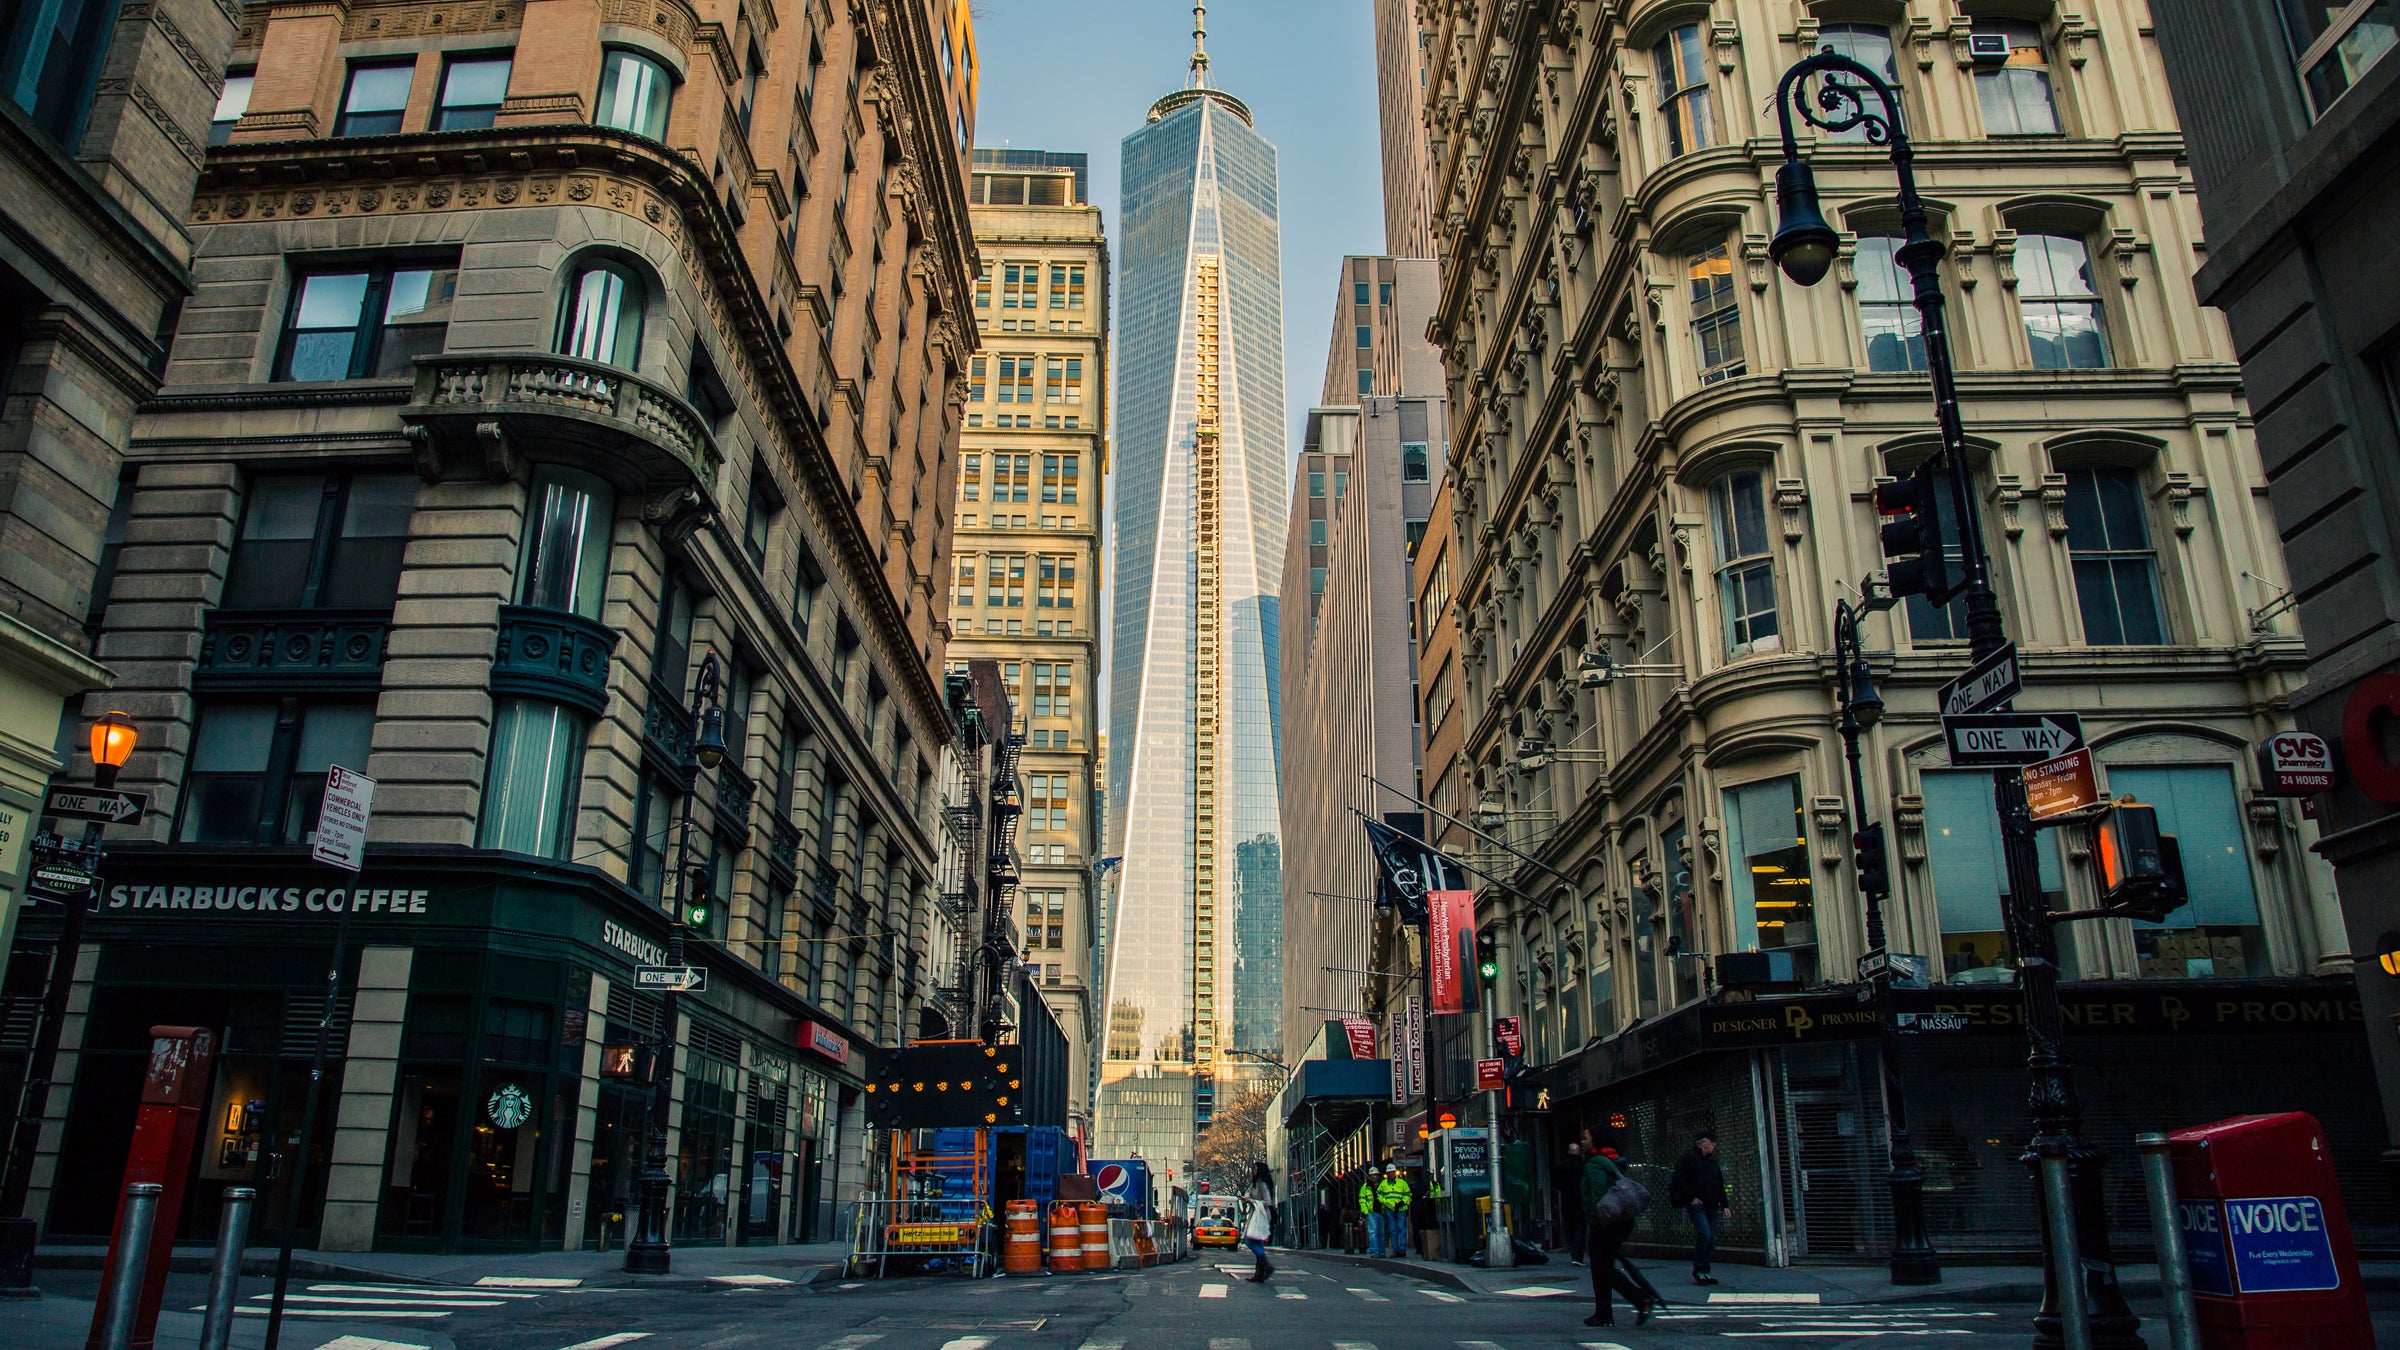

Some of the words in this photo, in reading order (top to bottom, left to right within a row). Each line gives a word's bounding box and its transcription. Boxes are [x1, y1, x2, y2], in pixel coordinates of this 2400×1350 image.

[1951, 688, 1974, 714] ONE
[1982, 664, 2007, 695] WAY
[1967, 731, 2007, 750] ONE
[2022, 730, 2061, 749] WAY
[2274, 738, 2325, 758] CVS
[2026, 769, 2038, 780] NO
[2040, 757, 2079, 777] STANDING
[2278, 759, 2325, 768] pharmacy
[331, 769, 340, 787] 3
[2029, 779, 2052, 791] Monday
[2057, 772, 2077, 783] Friday
[2281, 776, 2293, 785] 24
[2295, 776, 2328, 785] HOURS
[328, 793, 362, 811] COMMERCIAL
[2030, 792, 2044, 801] 7am
[2048, 787, 2062, 797] 7pm
[58, 796, 87, 809] ONE
[99, 799, 129, 814] WAY
[326, 803, 351, 818] VEHICLES
[352, 811, 365, 822] ONLY
[321, 826, 331, 835] 7am
[334, 830, 344, 839] 7pm
[323, 815, 339, 825] OTHERS
[345, 822, 364, 833] STANDING
[320, 835, 334, 846] Except
[335, 839, 351, 851] Sunday
[50, 881, 76, 890] COFFEE
[109, 885, 300, 912] STARBUCKS
[305, 888, 428, 913] COFFEE
[604, 920, 661, 966] STARBUCKS
[646, 973, 665, 982] ONE
[675, 973, 695, 983] WAY
[1435, 965, 1444, 995] Hospital
[1411, 998, 1419, 1048] Roberts
[1712, 1017, 1778, 1033] DESIGNER
[1820, 1010, 1881, 1027] PROMISE
[1921, 1018, 1961, 1030] NASSAU
[1394, 1014, 1402, 1061] Roberts
[2235, 1202, 2319, 1234] VOICE
[2262, 1250, 2278, 1259] Every
